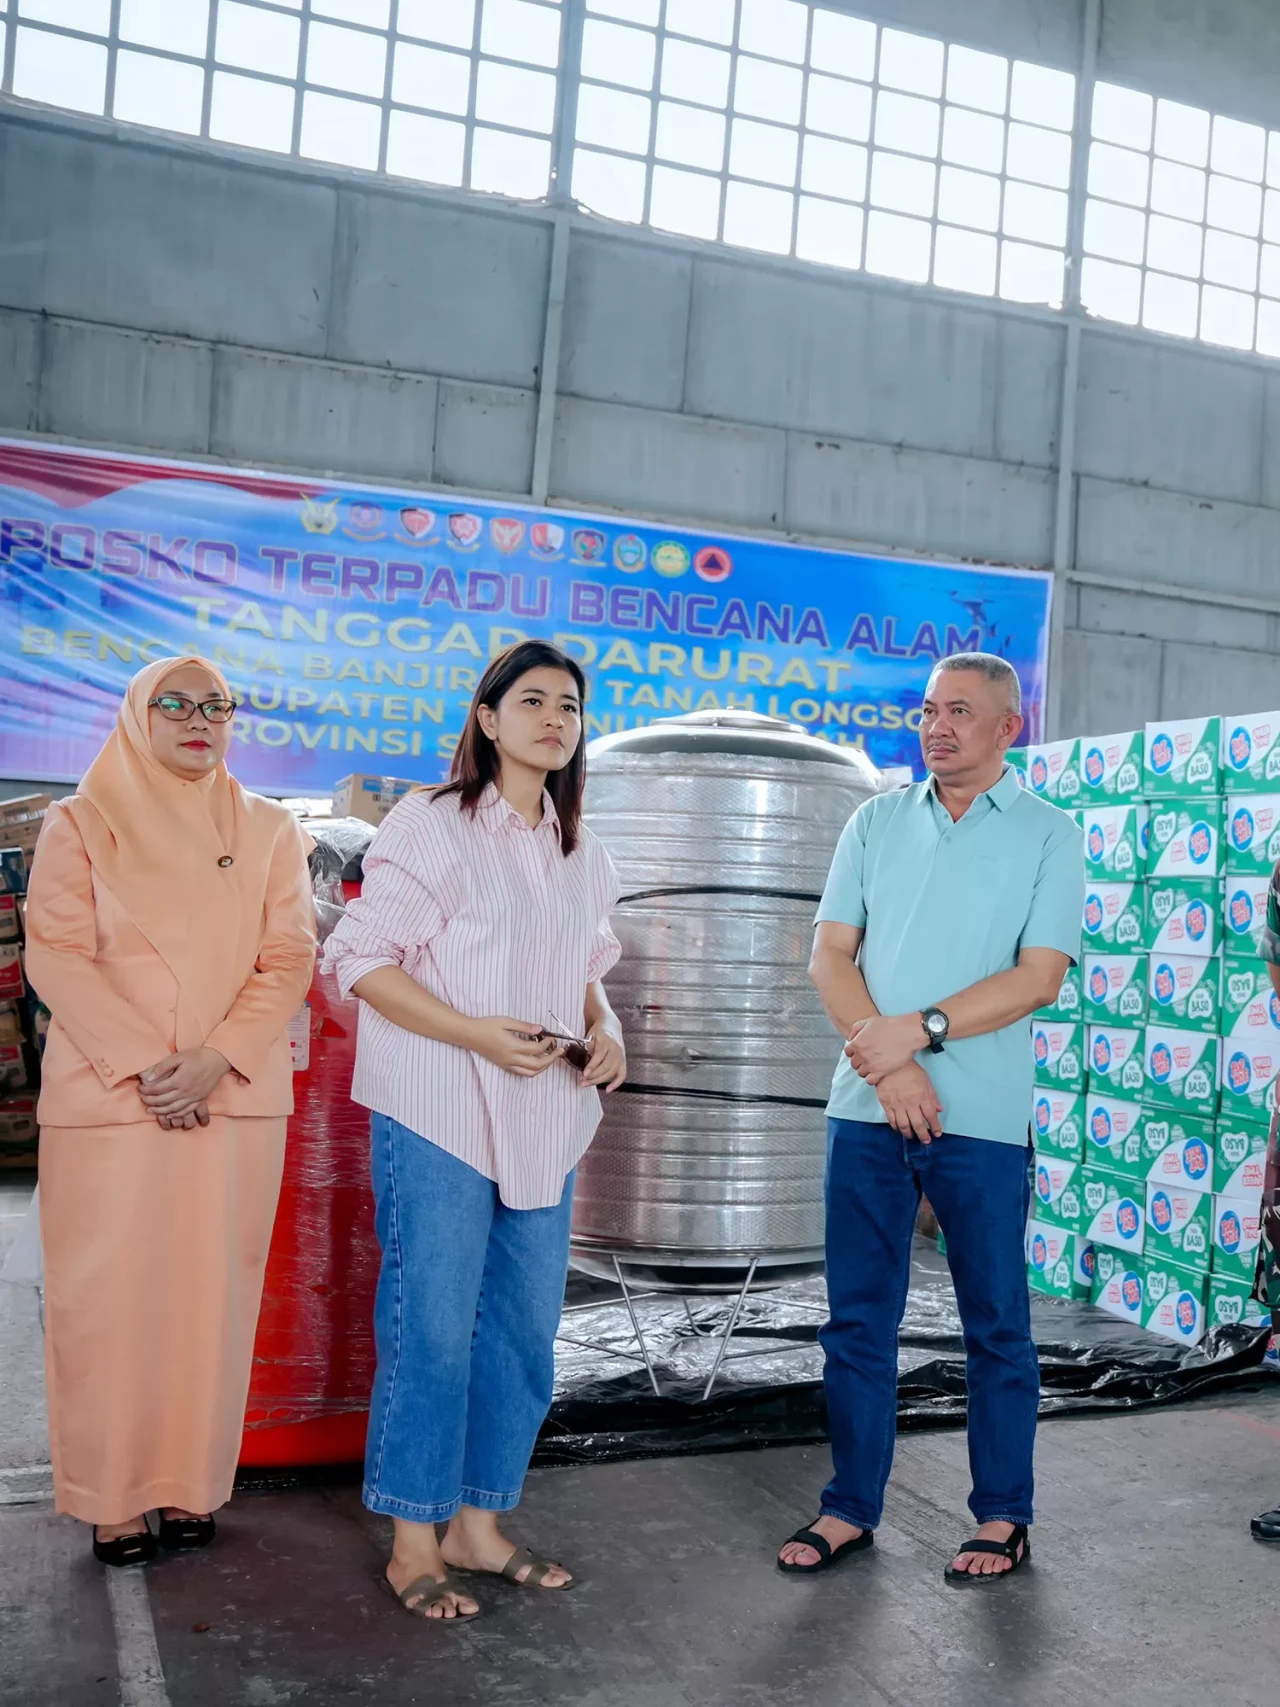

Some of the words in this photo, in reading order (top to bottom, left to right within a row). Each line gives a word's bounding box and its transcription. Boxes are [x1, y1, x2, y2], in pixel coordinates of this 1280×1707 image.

[0, 518, 239, 587] POSKO
[260, 545, 552, 620] TERPADU
[568, 580, 832, 650] BENCANA
[845, 613, 983, 660] ALAM
[303, 652, 482, 693] BANJIR
[553, 631, 852, 692] DARURAT
